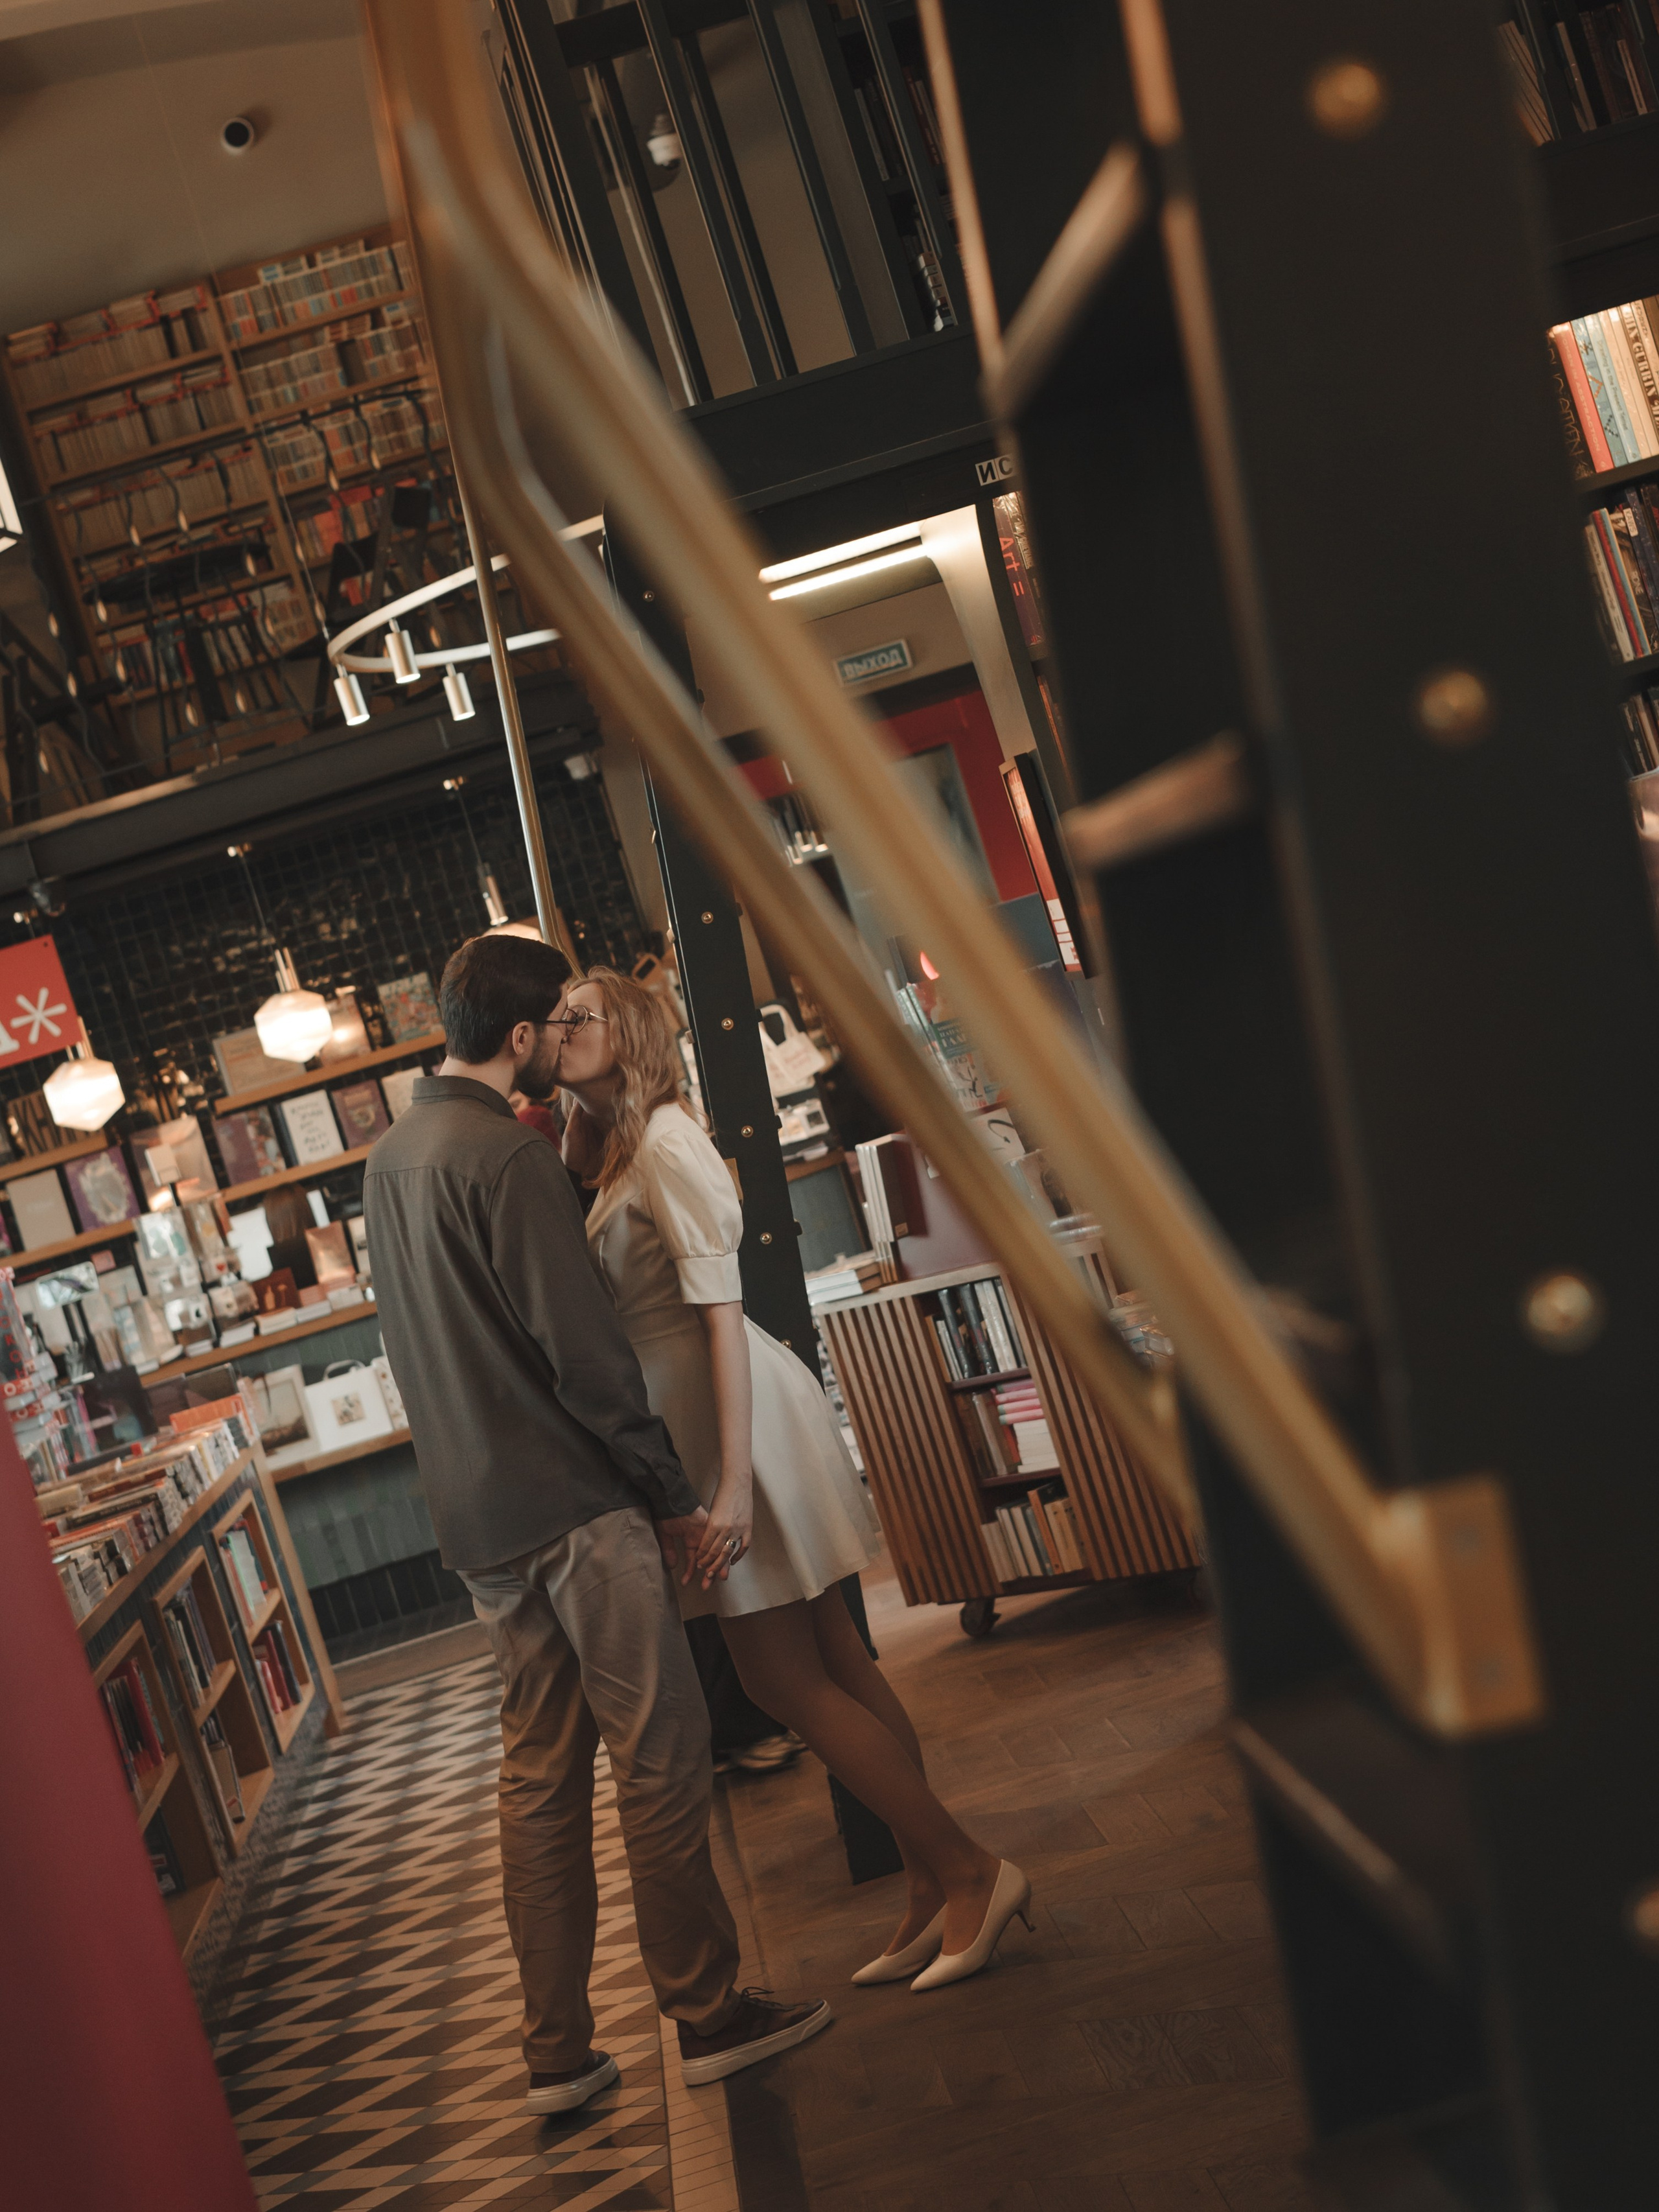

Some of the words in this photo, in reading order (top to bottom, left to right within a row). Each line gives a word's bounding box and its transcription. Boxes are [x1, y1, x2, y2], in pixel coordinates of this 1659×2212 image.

[1632, 342, 1658, 397] CURRIN
[1575, 382, 1600, 451] ABSTRACTION
[1625, 510, 1636, 532] KAWS
[998, 537, 1021, 572] Art
[1630, 571, 1643, 595] RONE
[844, 649, 904, 679] ВЫХОД
